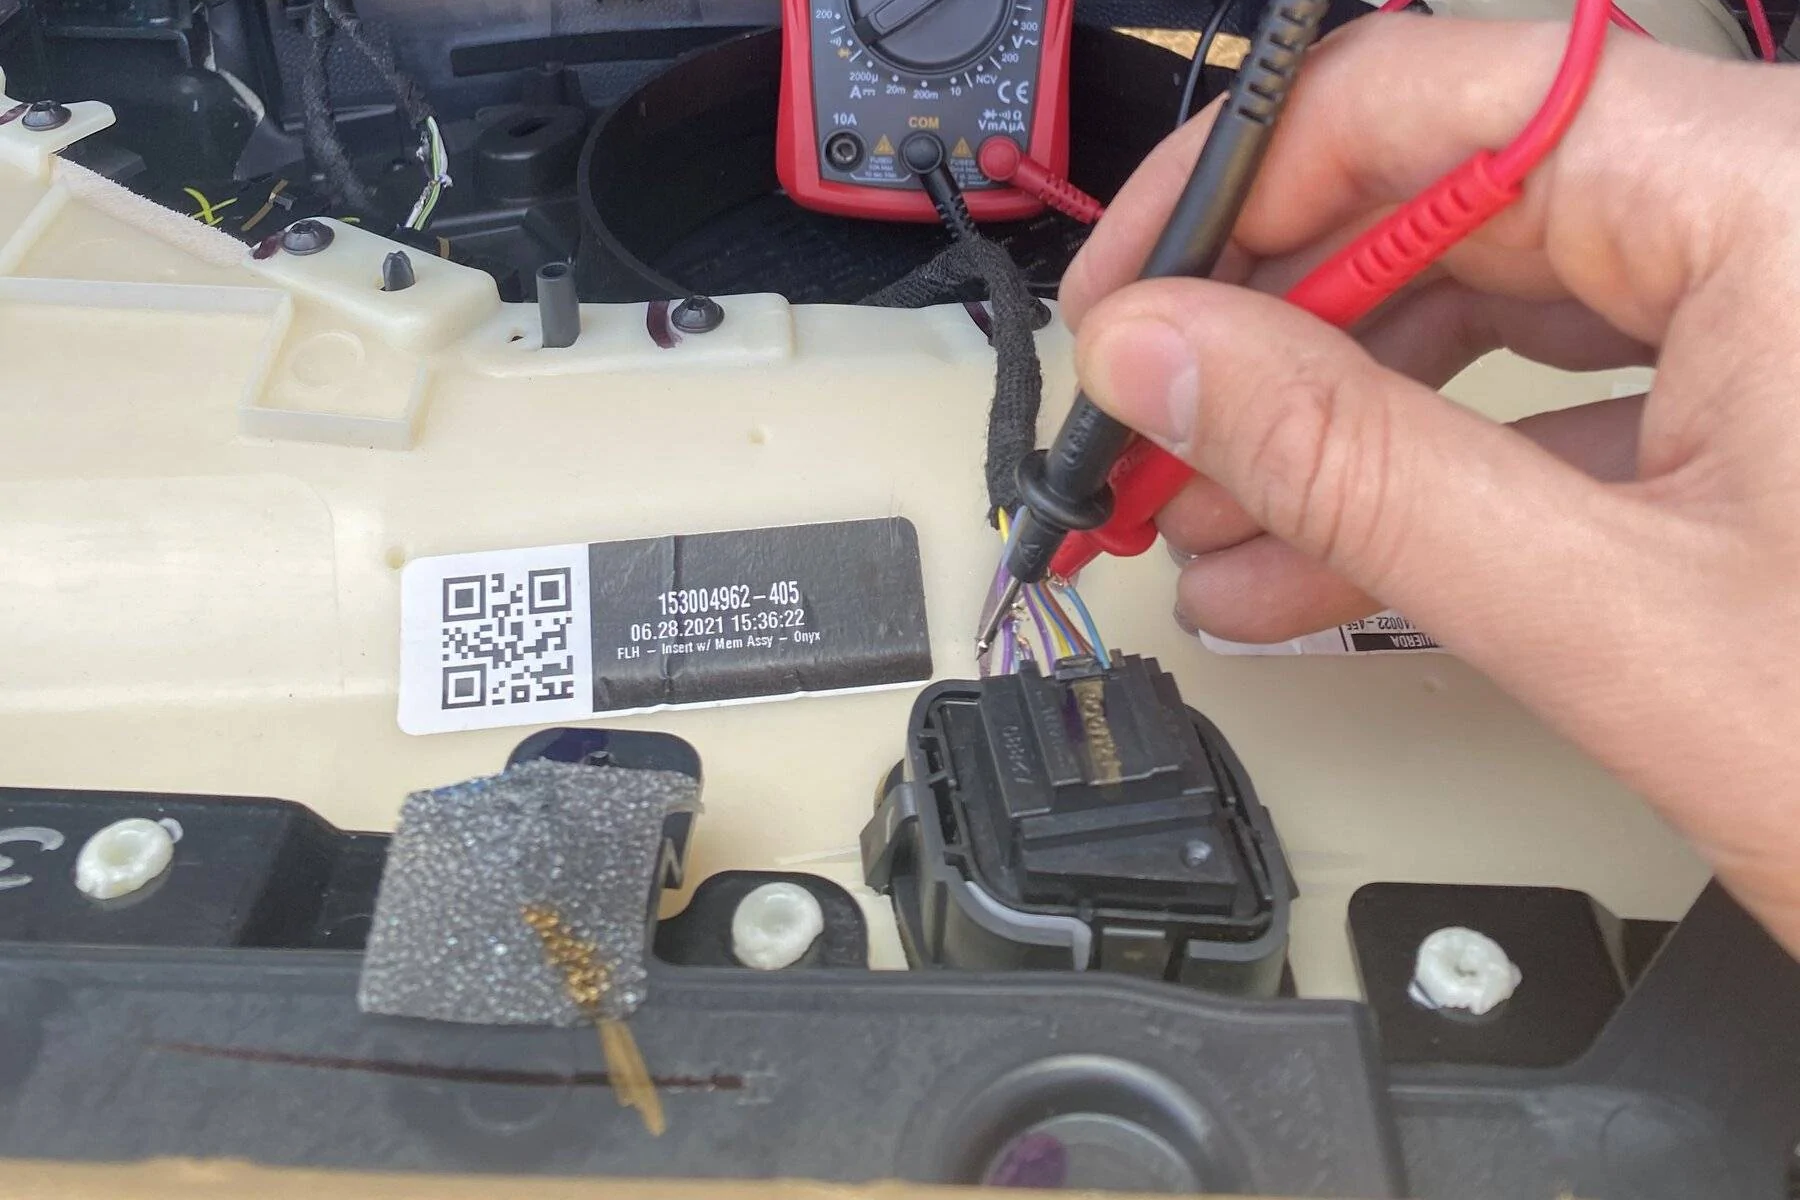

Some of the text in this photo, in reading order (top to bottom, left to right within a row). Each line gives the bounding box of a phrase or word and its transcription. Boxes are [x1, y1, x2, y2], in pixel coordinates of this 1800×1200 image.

[816, 10, 832, 19] 200
[1021, 22, 1038, 32] 300
[1001, 53, 1019, 63] 200
[976, 74, 997, 85] NCV
[886, 84, 906, 95] 20m
[913, 89, 939, 100] 200m
[951, 86, 962, 97] 10
[833, 113, 857, 126] 10A
[908, 116, 940, 129] COM
[630, 608, 805, 642] 06.28.2021 15:36:22
[617, 646, 640, 660] FLH
[662, 642, 693, 655] Insert
[697, 638, 711, 651] w/
[715, 637, 743, 650] Mem
[747, 635, 773, 648] Assy
[794, 630, 821, 644] Onyx
